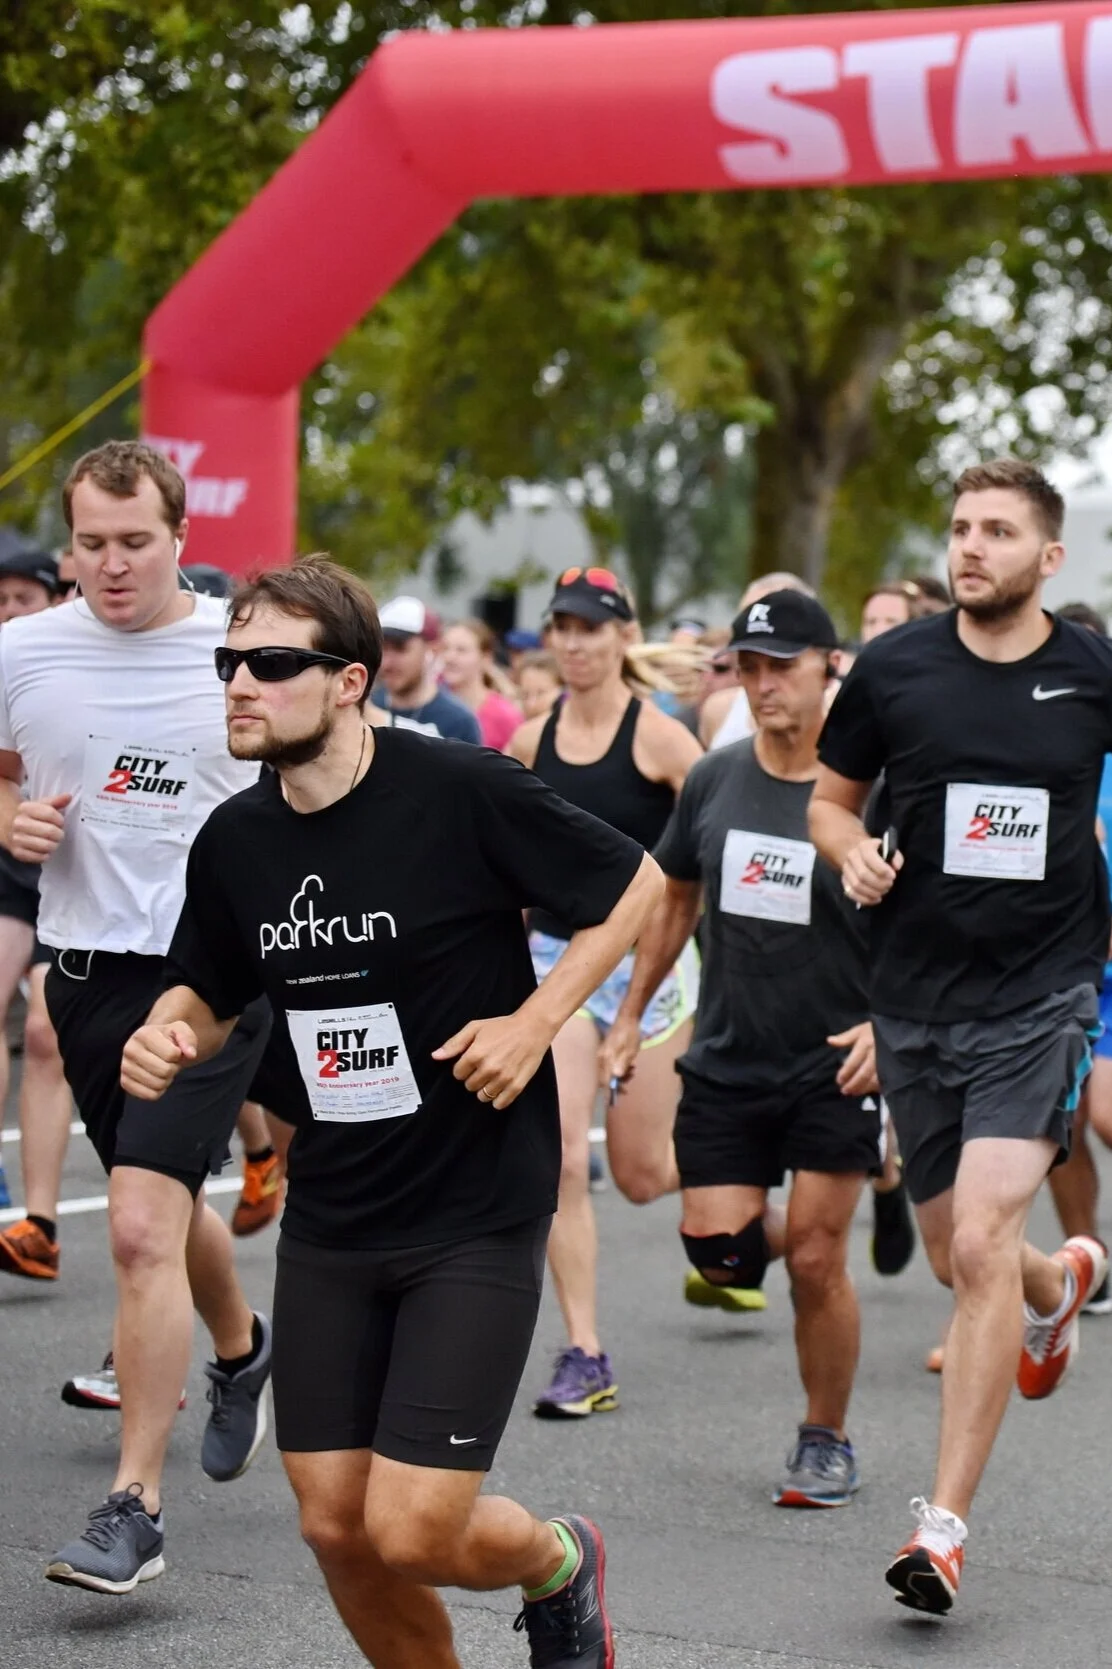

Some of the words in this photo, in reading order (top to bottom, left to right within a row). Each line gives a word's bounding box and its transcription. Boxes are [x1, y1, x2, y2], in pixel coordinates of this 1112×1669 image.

[114, 755, 169, 775] CITY
[103, 770, 187, 795] 2SURF
[974, 804, 1022, 819] CITY
[965, 817, 1041, 840] 2SURF
[751, 853, 790, 868] CITY
[260, 876, 397, 959] parkrun
[298, 974, 324, 985] zealand
[325, 973, 341, 981] HOME
[342, 971, 360, 980] LOANS
[317, 1028, 368, 1051] CITY
[317, 1045, 399, 1078] 2SURF
[380, 1076, 400, 1085] 2019
